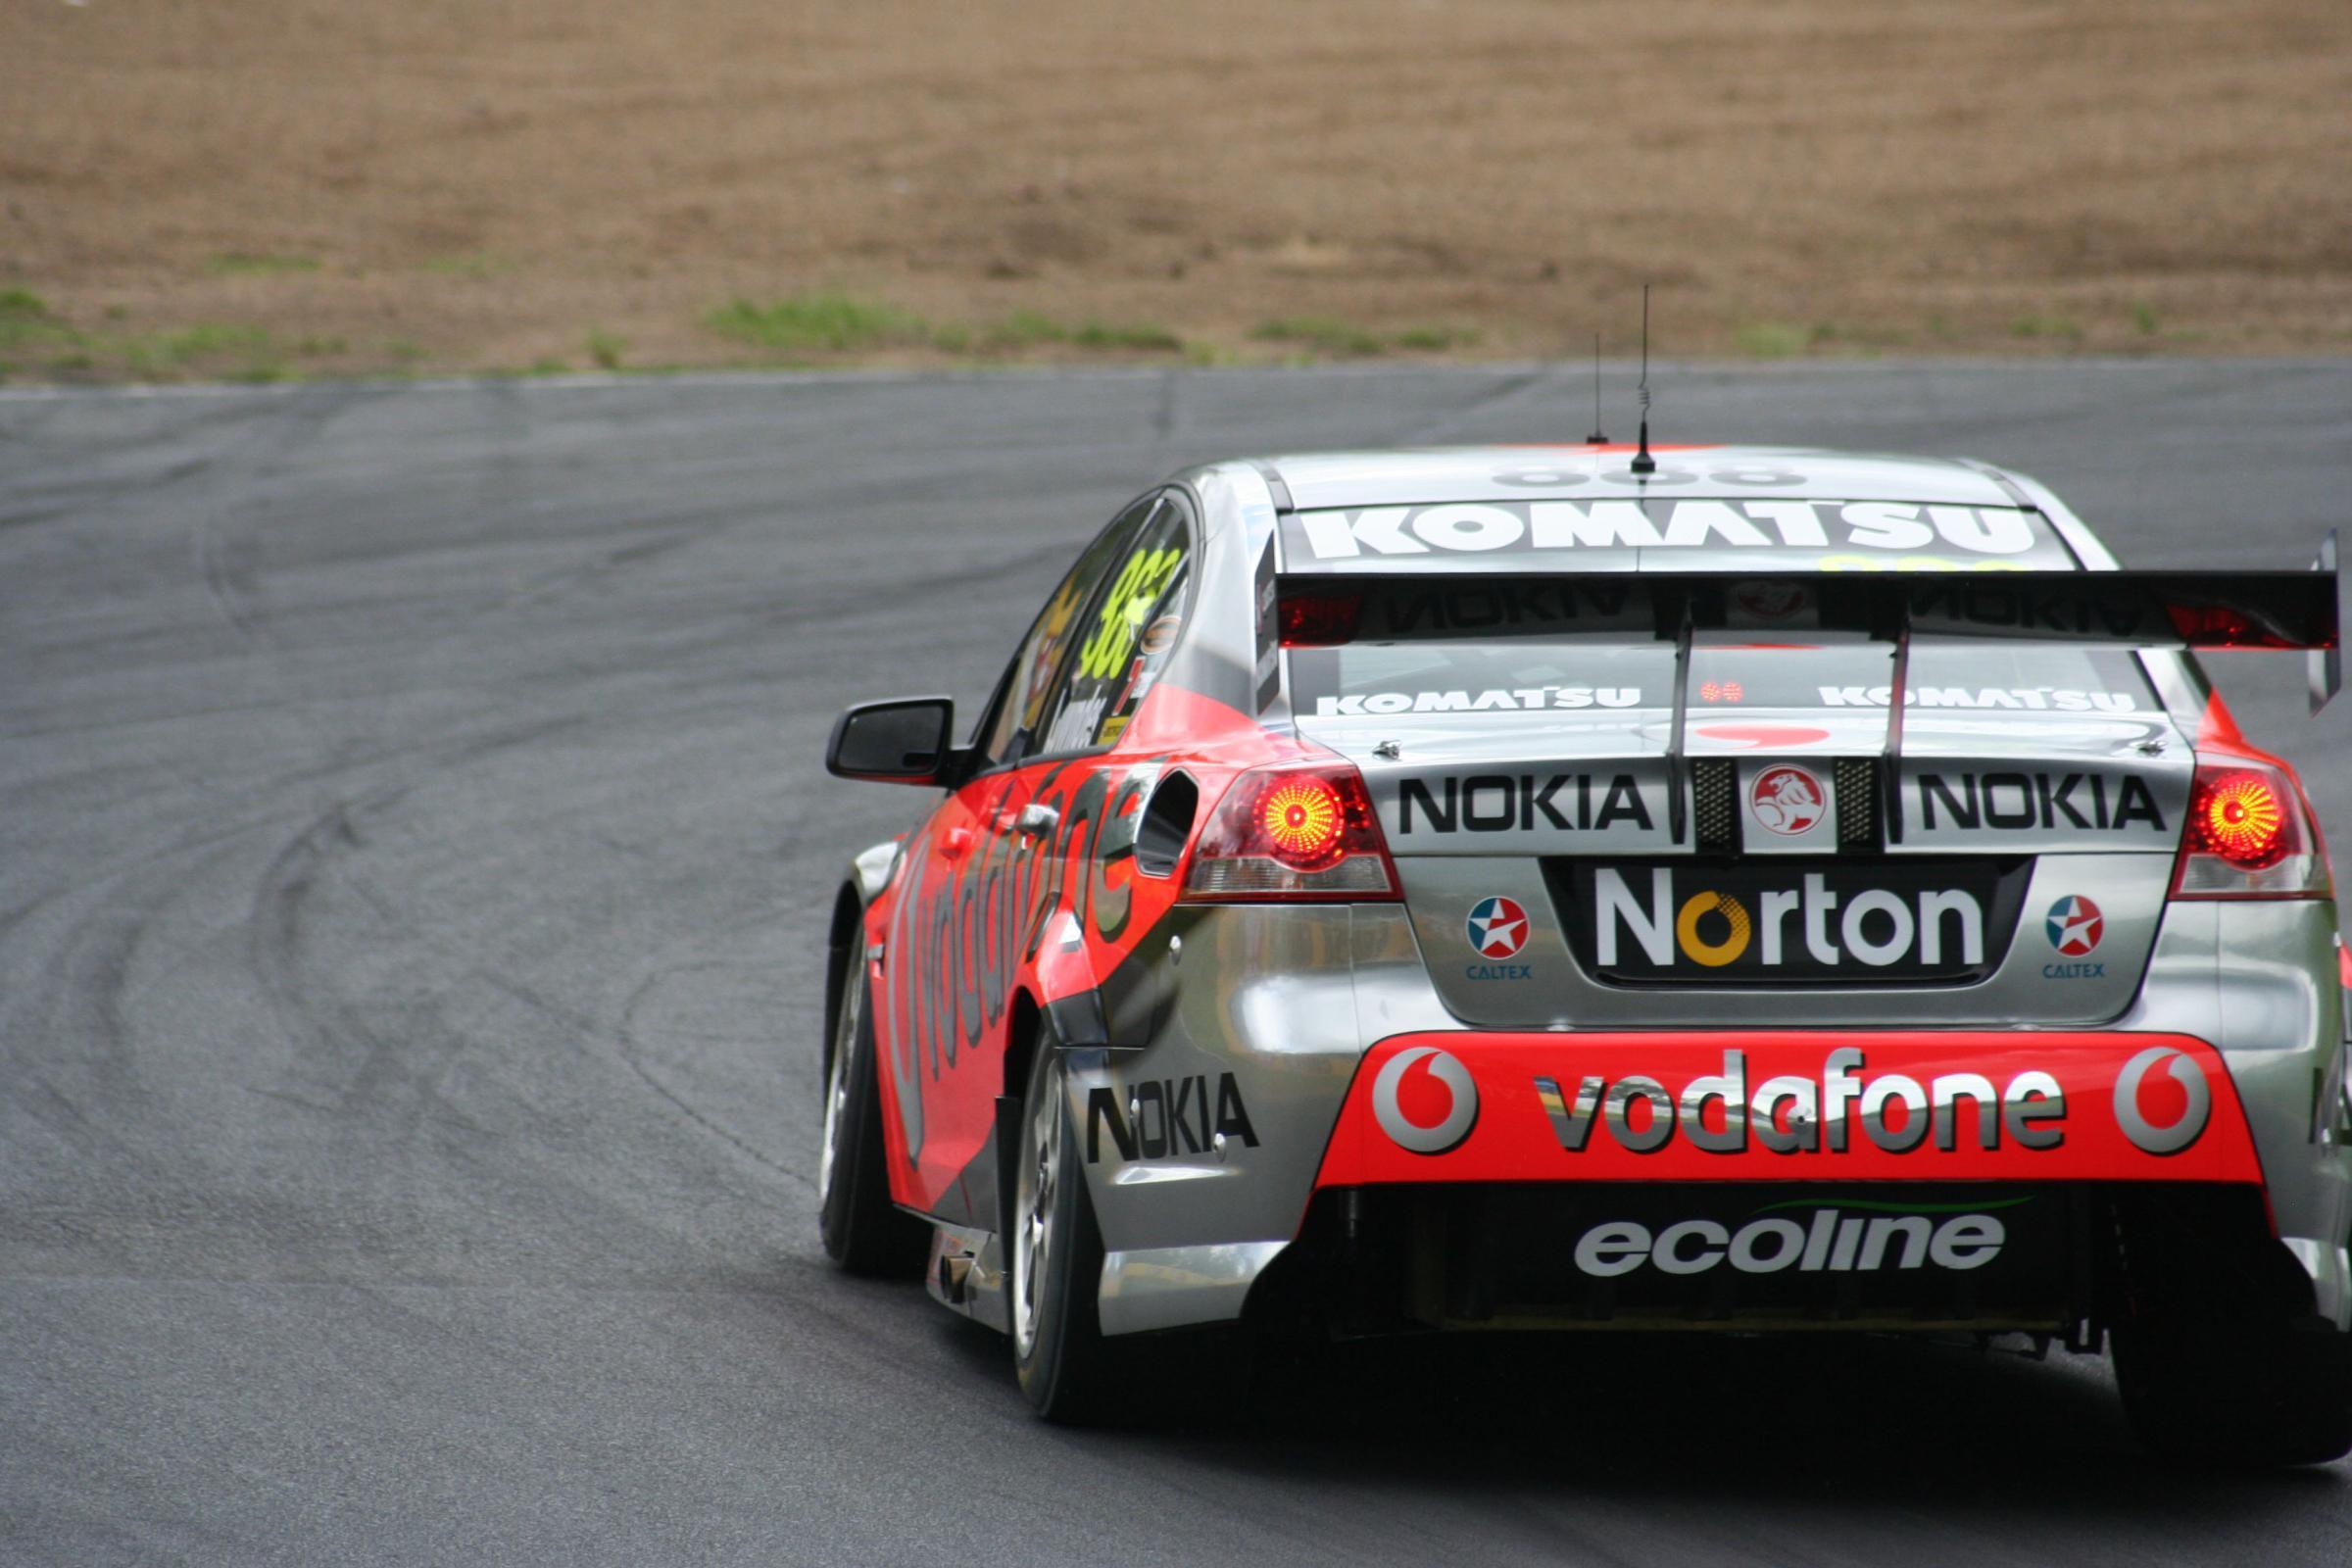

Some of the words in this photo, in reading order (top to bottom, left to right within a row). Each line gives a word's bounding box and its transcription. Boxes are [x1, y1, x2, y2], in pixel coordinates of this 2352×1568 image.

[1299, 499, 2035, 559] KOMATSU
[1316, 686, 1642, 716] KOMATSU
[1818, 685, 2136, 712] KOMATSU
[1398, 773, 1654, 834] NOKIA
[1917, 772, 2168, 832] NOKIA
[1594, 867, 1984, 967] Norton
[1466, 964, 1532, 980] CALTEX
[2042, 963, 2105, 978] CALTEX
[1087, 1071, 1260, 1163] NOKIA
[1533, 1047, 2067, 1155] vodafone
[1574, 1208, 2006, 1277] ecoline
